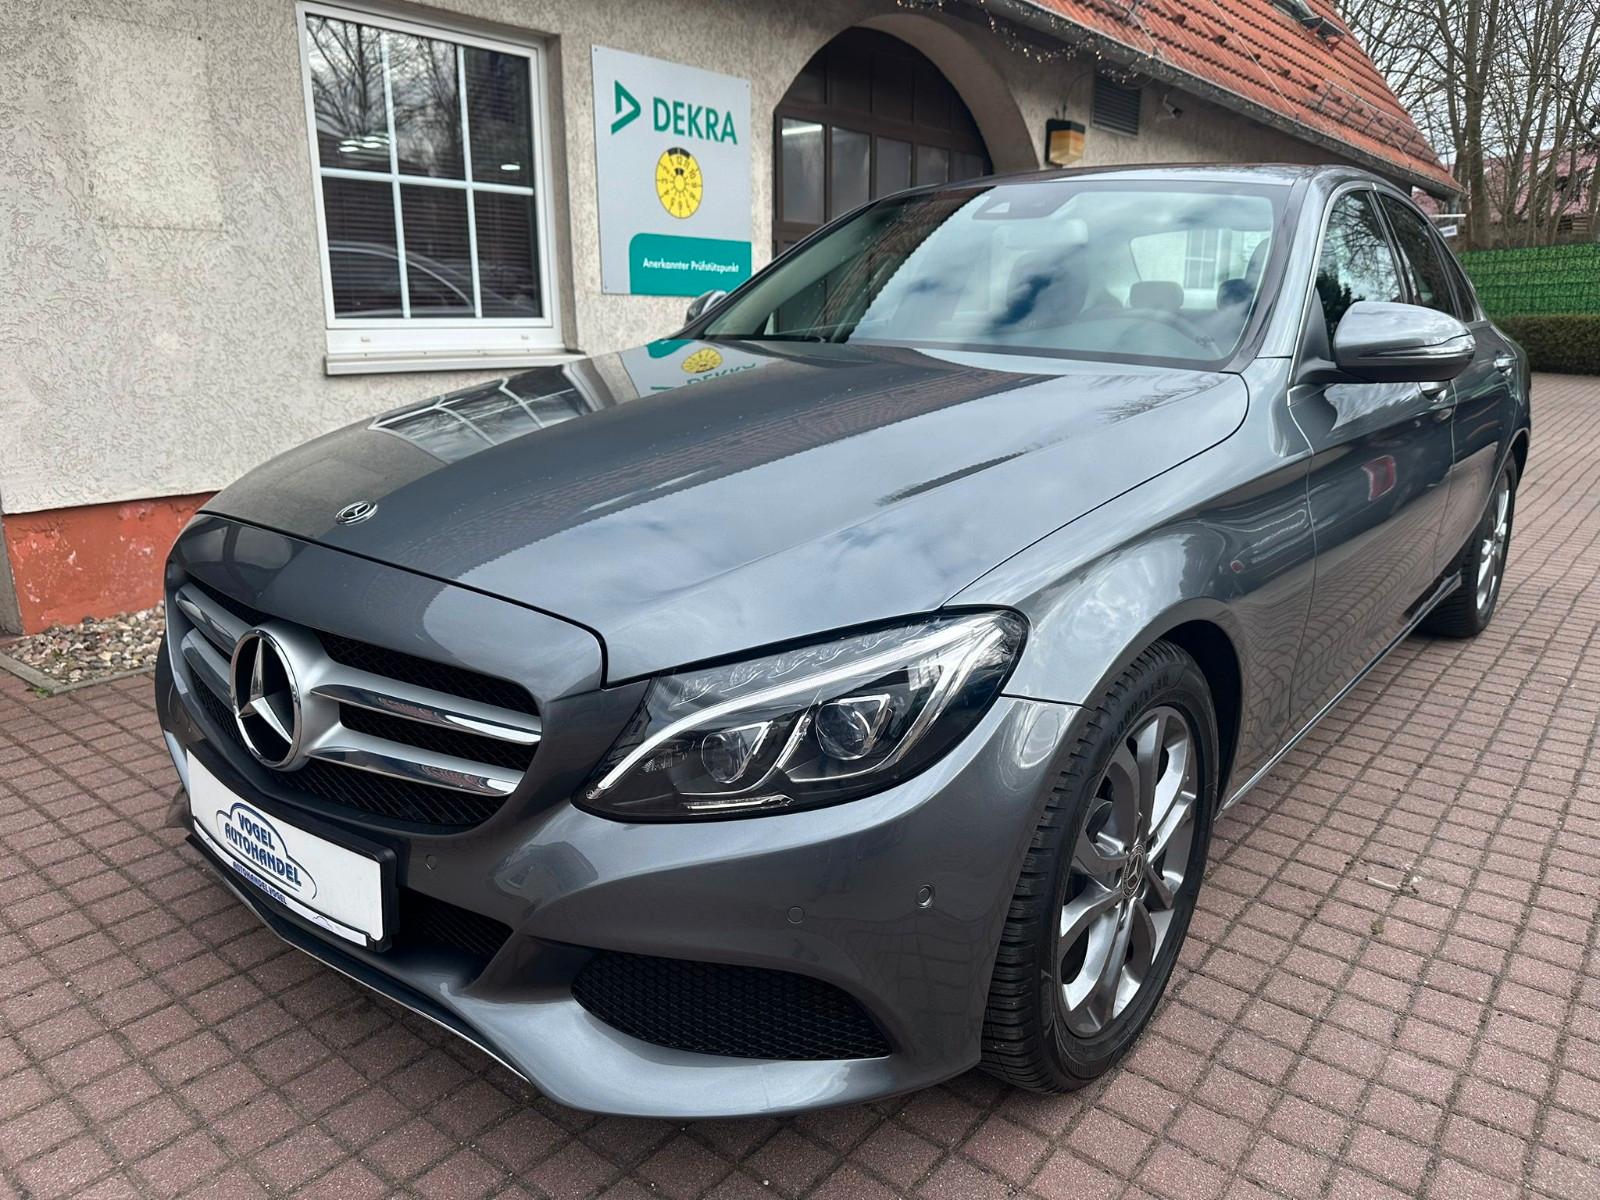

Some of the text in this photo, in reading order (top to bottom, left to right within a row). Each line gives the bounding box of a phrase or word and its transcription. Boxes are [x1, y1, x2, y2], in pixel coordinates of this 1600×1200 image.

[653, 96, 738, 145] DEKRA
[643, 257, 739, 274] Anerkannter Prüfstützpunkt
[237, 812, 275, 851] VOGEL
[225, 822, 302, 887] AUTOHANDEL
[269, 886, 287, 904] VOGEL
